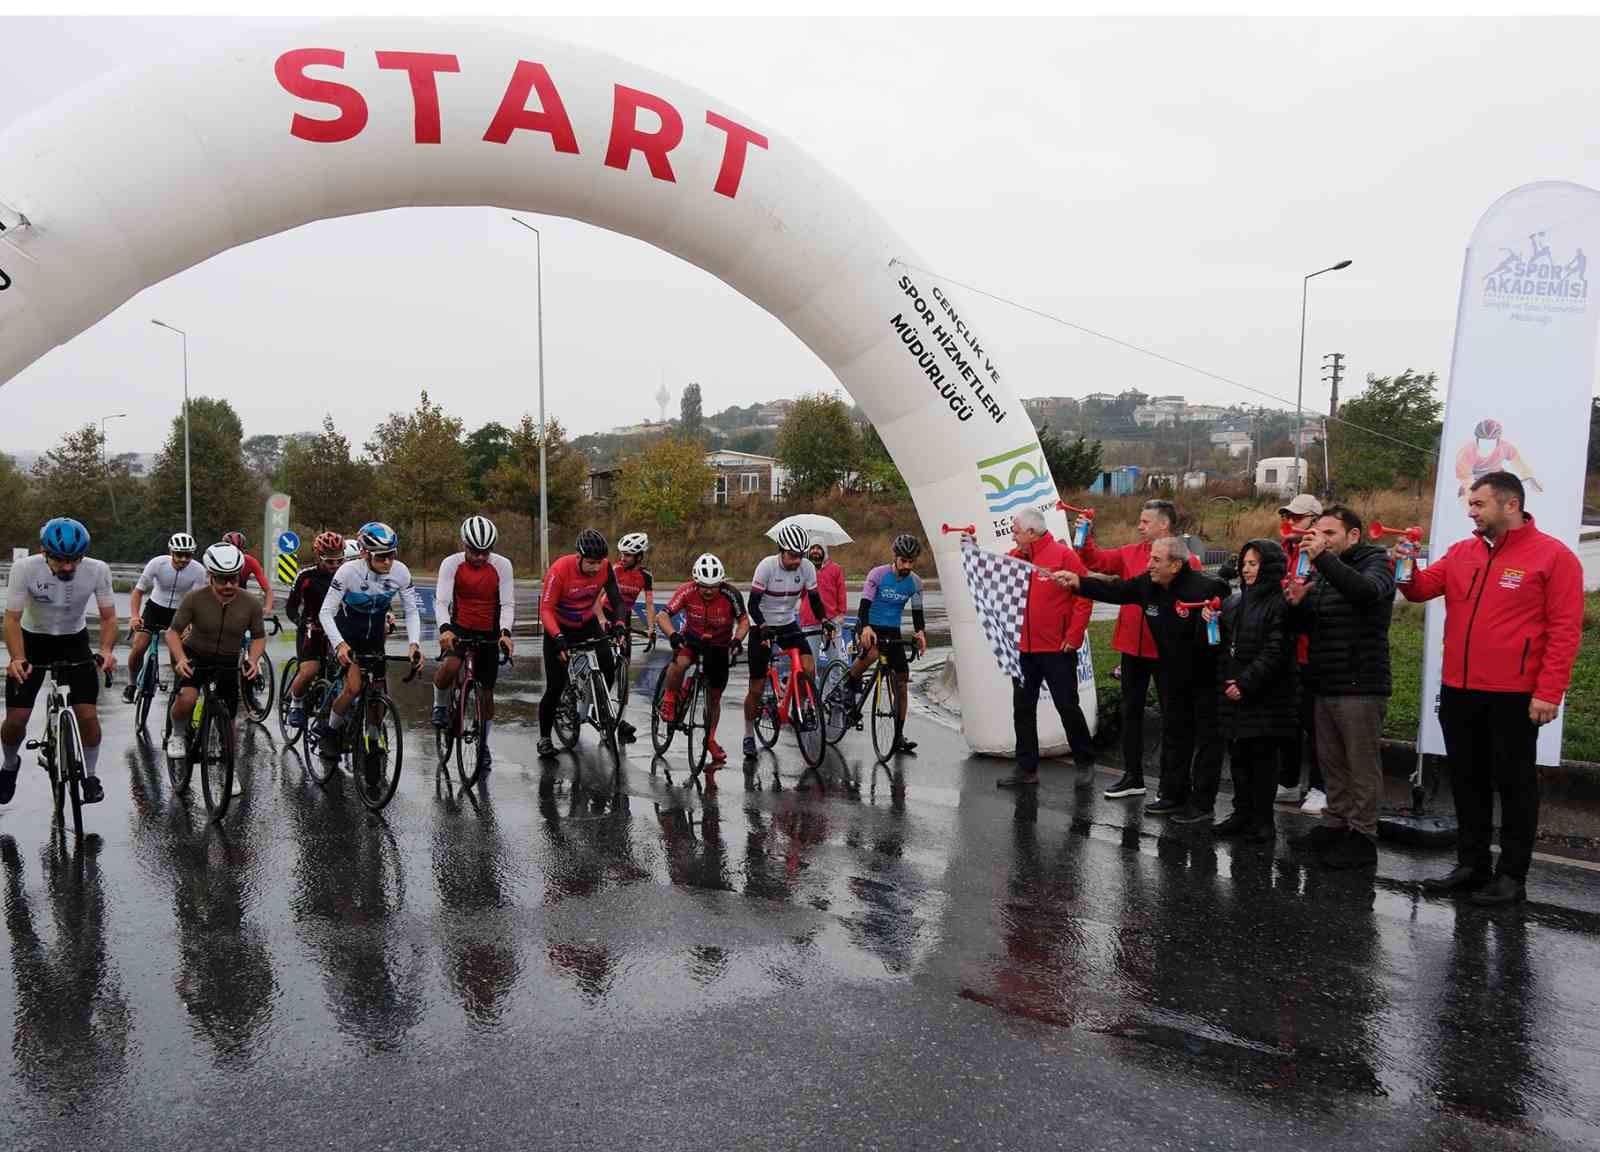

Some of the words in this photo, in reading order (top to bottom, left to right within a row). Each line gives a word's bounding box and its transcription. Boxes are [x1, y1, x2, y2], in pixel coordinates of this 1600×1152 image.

[274, 48, 768, 198] START
[1513, 263, 1563, 280] SPOR
[890, 313, 974, 422] MÜDÜRLÜĞÜ
[898, 275, 935, 327] SPOR
[932, 324, 1007, 424] HİZMETLERİ
[985, 358, 1001, 384] VE
